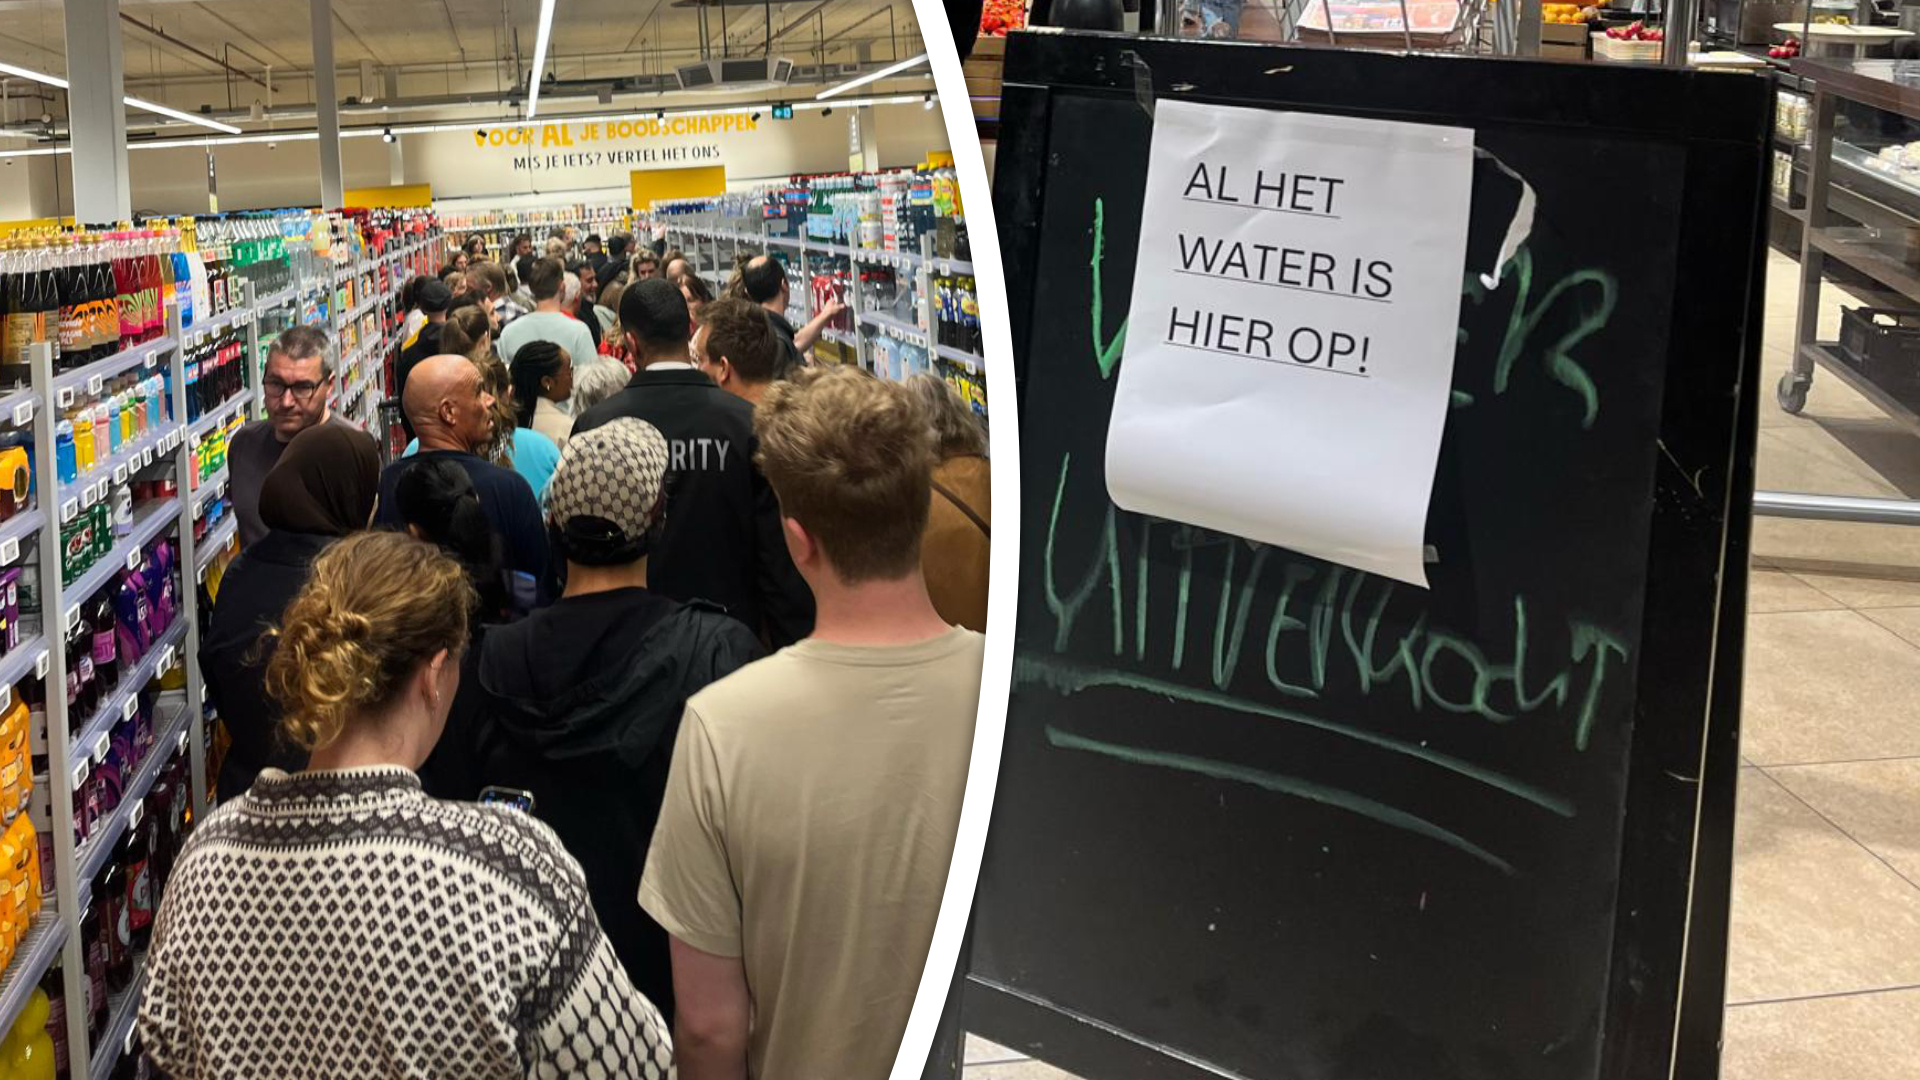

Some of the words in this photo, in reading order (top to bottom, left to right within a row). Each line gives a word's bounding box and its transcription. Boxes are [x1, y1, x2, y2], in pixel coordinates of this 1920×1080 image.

[473, 127, 534, 148] VOOR
[541, 122, 574, 148] AL
[580, 121, 600, 142] JE
[606, 112, 758, 140] BOODSCHAPPEN
[513, 156, 541, 170] MIS
[545, 155, 560, 169] JE
[563, 153, 602, 168] IETS?
[607, 148, 659, 164] VERTEL
[662, 146, 687, 161] HET
[692, 144, 720, 159] ONS
[1183, 162, 1239, 202] AL
[1253, 170, 1345, 214] HET
[1178, 233, 1336, 291] WATER
[1351, 257, 1393, 298] IS
[1168, 306, 1274, 357] HIER
[1288, 326, 1370, 374] OP!
[670, 438, 730, 471] RITY
